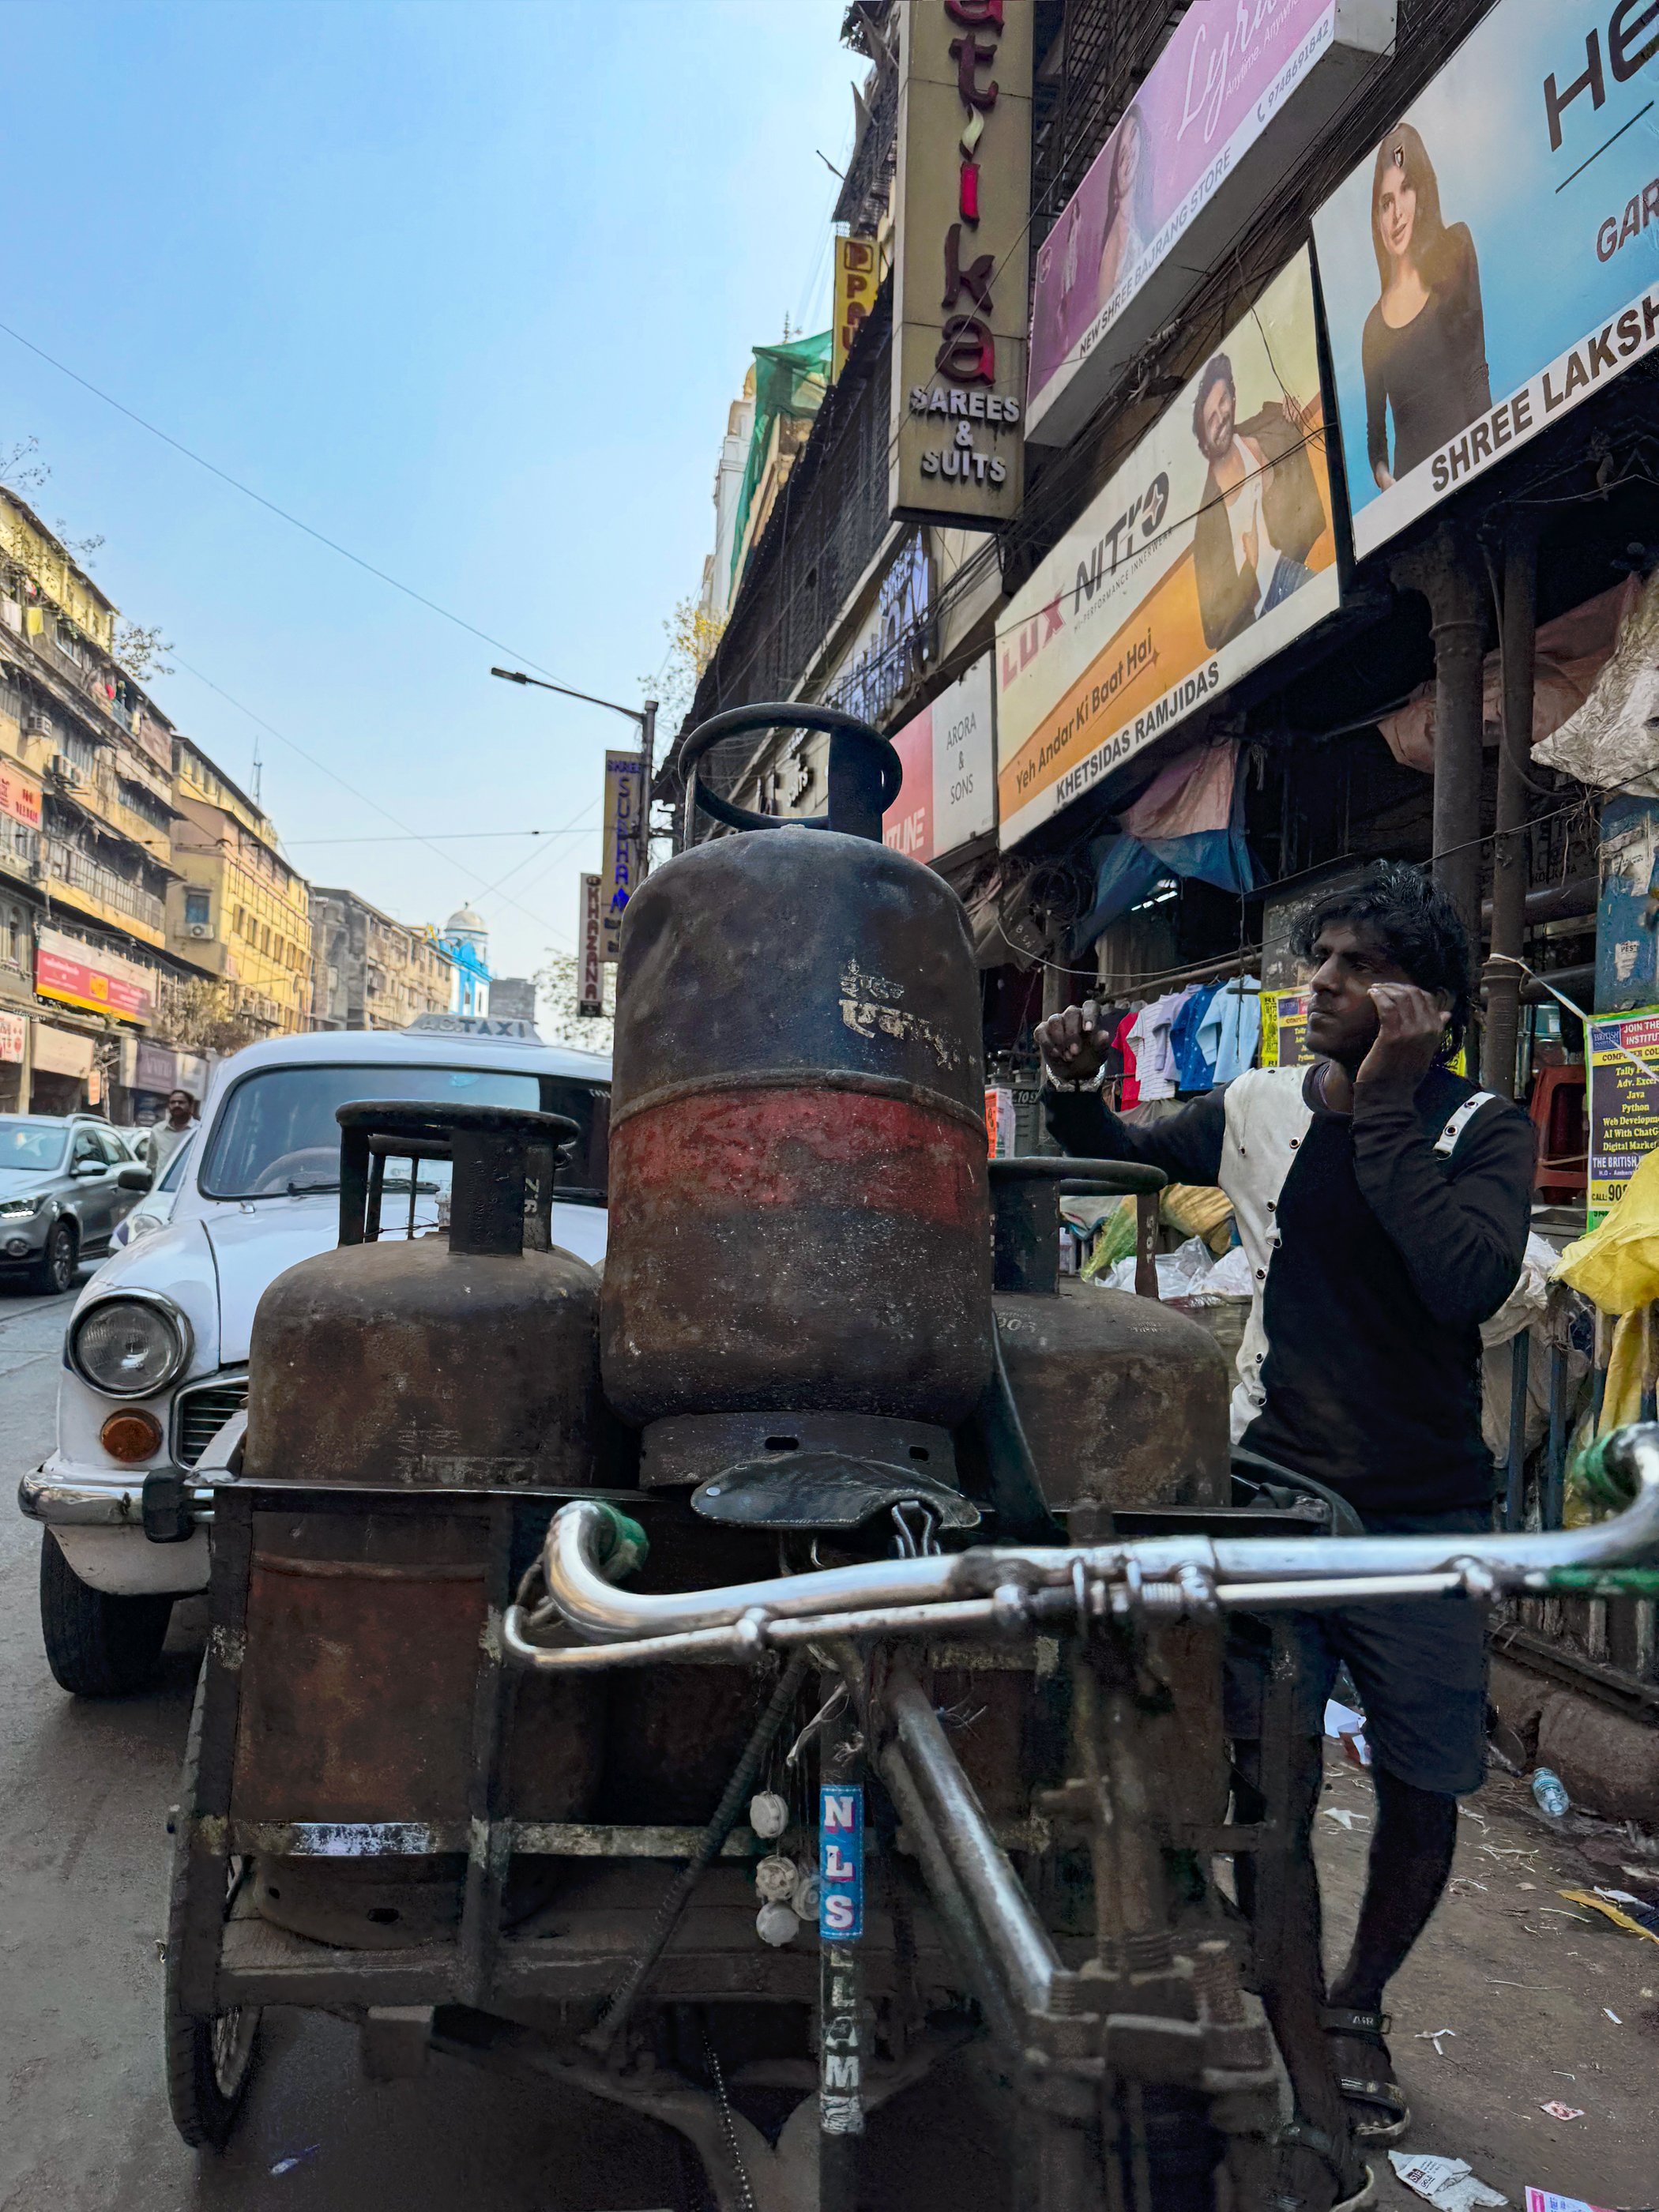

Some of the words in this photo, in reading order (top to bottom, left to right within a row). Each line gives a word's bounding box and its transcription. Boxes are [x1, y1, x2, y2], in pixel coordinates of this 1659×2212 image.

[1079, 318, 1100, 358] NEW
[1101, 284, 1132, 330] SHREE
[1135, 205, 1187, 287] BAJRANG
[1191, 146, 1232, 213] STORE
[911, 386, 1019, 422] SAREES
[956, 420, 974, 446] &
[1431, 388, 1533, 492] SHREE
[923, 449, 1006, 482] SUITS
[1130, 525, 1172, 581] INNERWEAR
[1003, 585, 1066, 691] LUX
[1016, 762, 1036, 793] Yeh
[1038, 718, 1074, 773] Andar
[1076, 694, 1089, 732] Ki
[1092, 660, 1123, 714] Baat
[1127, 626, 1152, 677] Hai
[947, 712, 976, 750] ARORA
[1056, 729, 1130, 803] KHETSIDAS
[1135, 661, 1220, 744] RAMJIDAS
[958, 751, 965, 770] &
[950, 774, 974, 804] SONS
[585, 887, 600, 999] KHAZANA
[1623, 1025, 1643, 1034] JOIN
[1616, 1066, 1635, 1076] Tally
[1616, 1079, 1635, 1089] Adv.
[1622, 1103, 1650, 1113] Python
[1626, 1090, 1645, 1100] Java
[1603, 1116, 1619, 1127] Web
[1604, 1130, 1612, 1139] AI
[1615, 1128, 1632, 1138] With
[1603, 1141, 1628, 1153] Digital
[1593, 1157, 1607, 1168] THE
[1608, 1156, 1638, 1168] BRITISH
[1592, 1193, 1608, 1202] CALL:
